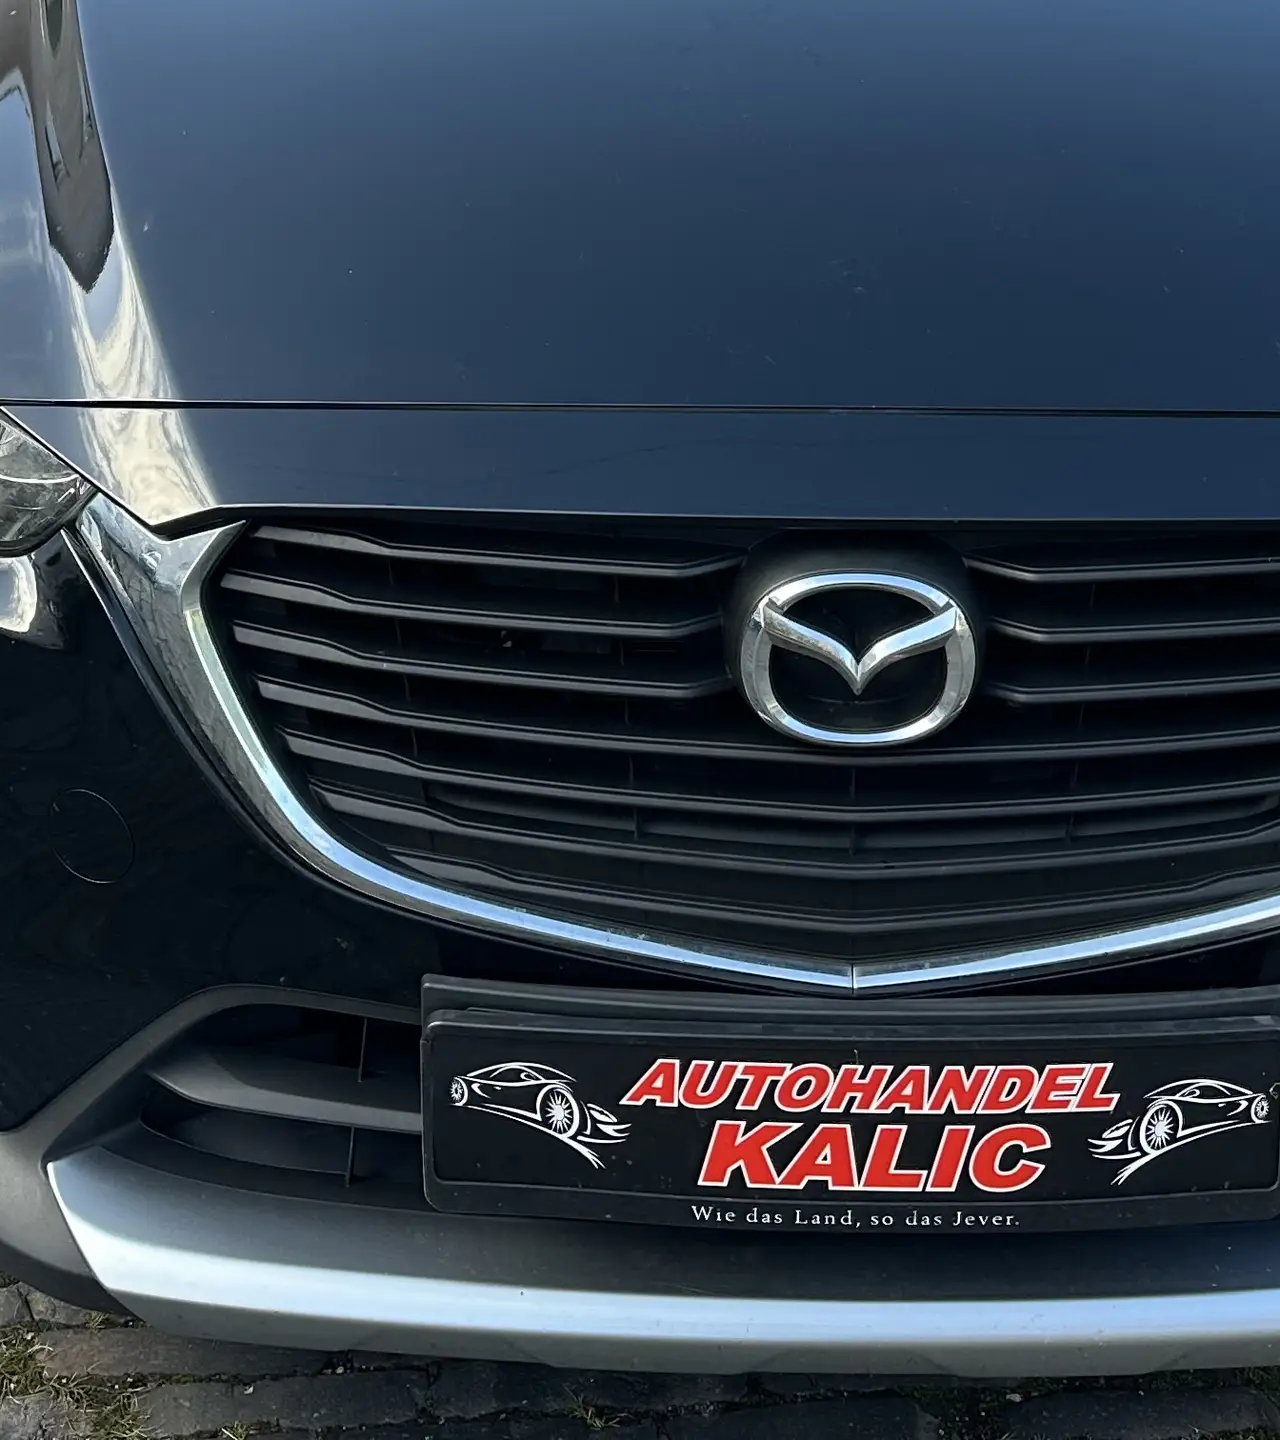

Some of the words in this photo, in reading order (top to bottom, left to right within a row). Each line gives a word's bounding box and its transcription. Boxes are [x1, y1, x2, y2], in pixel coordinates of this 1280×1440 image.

[619, 1058, 1120, 1115] AUTOHANDEL
[697, 1119, 1052, 1193] KALIC
[691, 1205, 737, 1223] Wie
[746, 1207, 783, 1225] das
[794, 1209, 862, 1229] Land,
[870, 1212, 894, 1227] so
[905, 1210, 943, 1227] das
[952, 1210, 1021, 1228] Jever.
